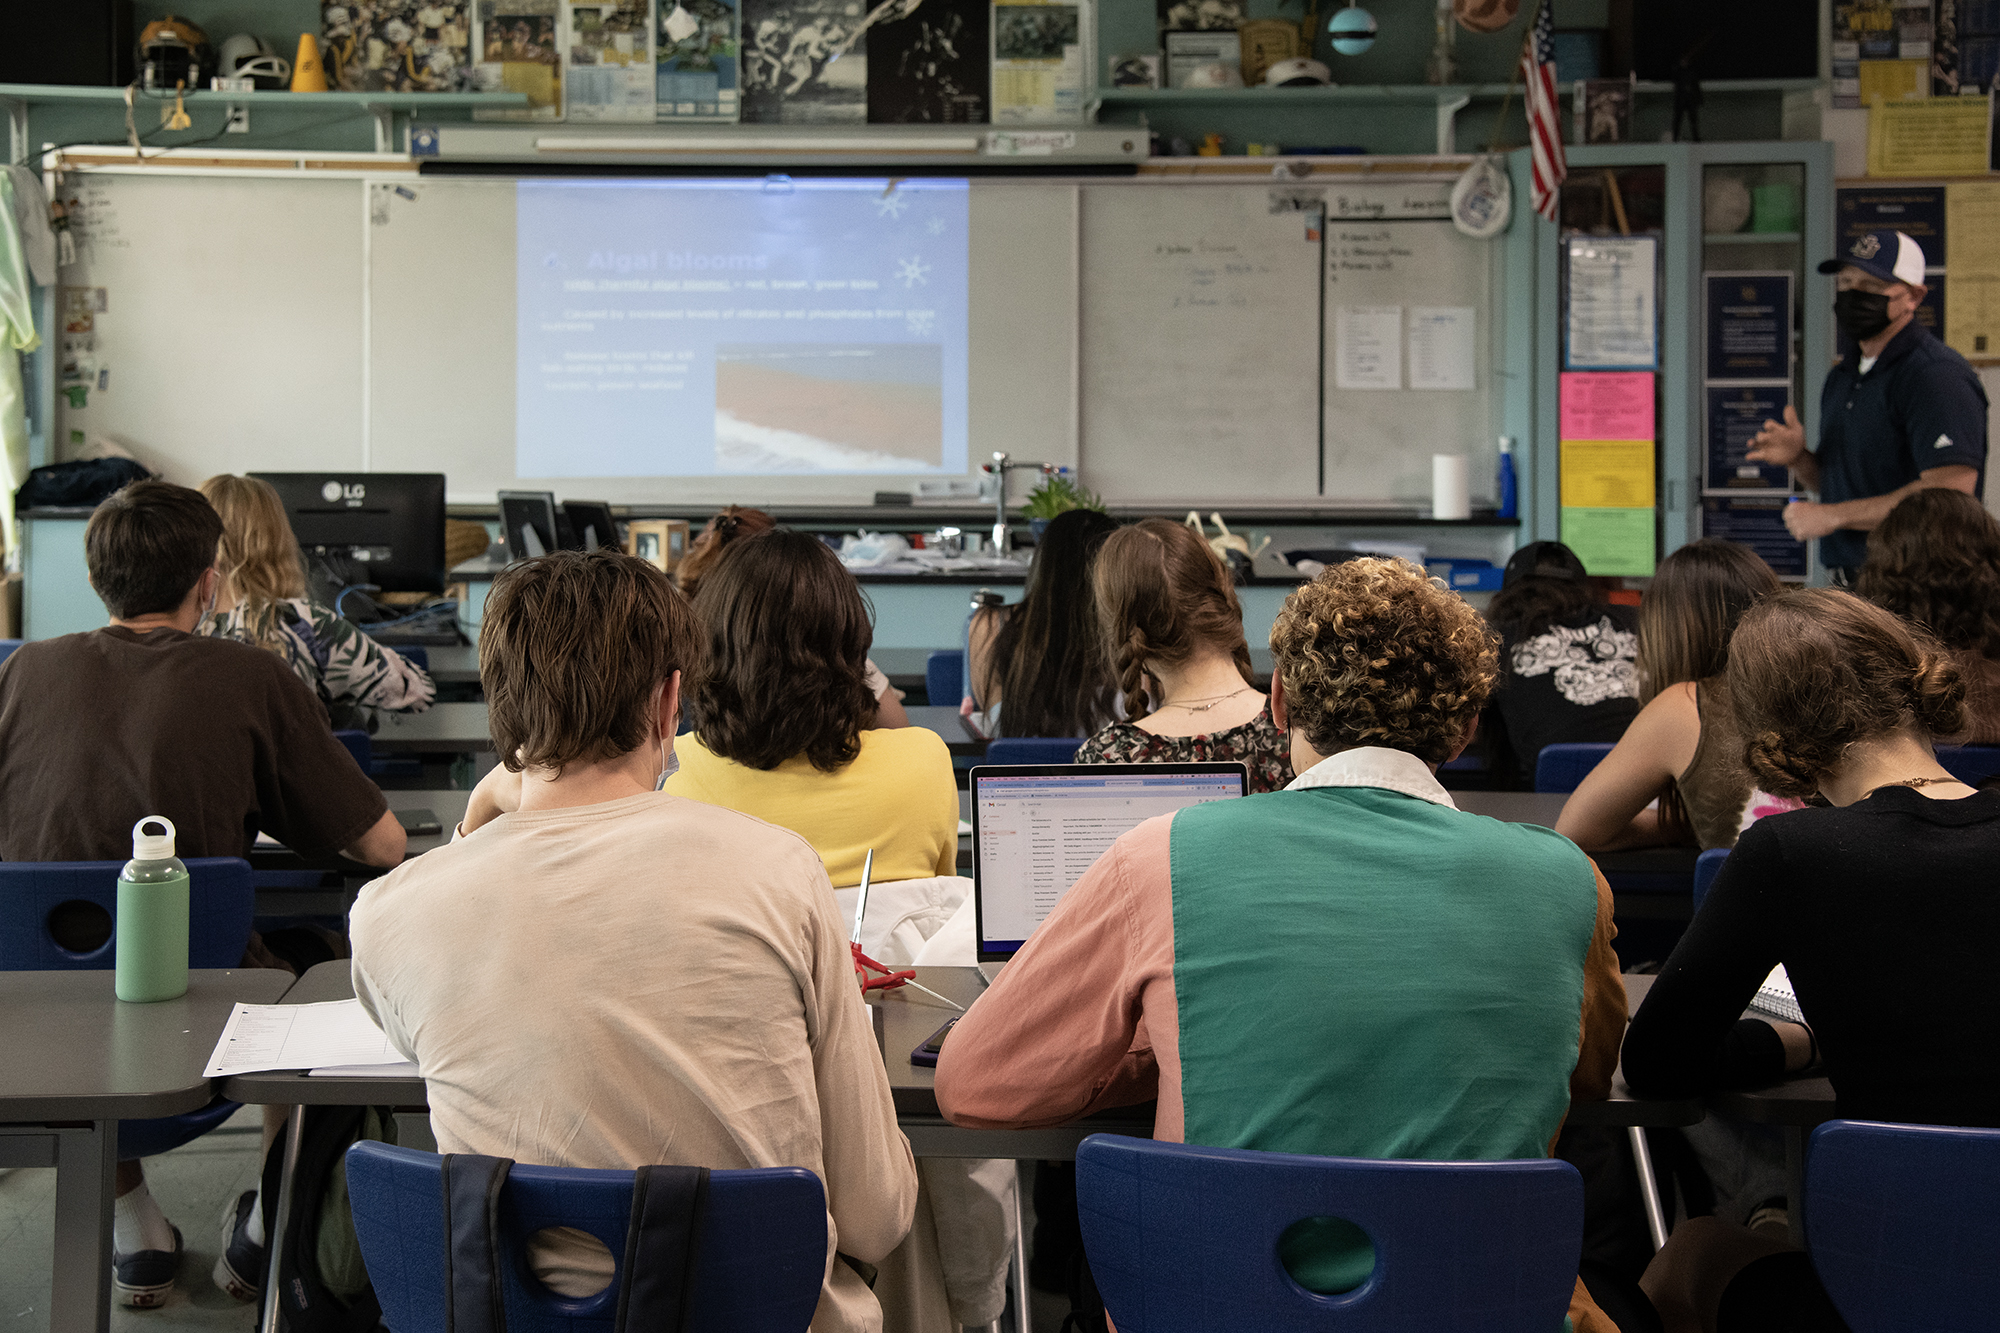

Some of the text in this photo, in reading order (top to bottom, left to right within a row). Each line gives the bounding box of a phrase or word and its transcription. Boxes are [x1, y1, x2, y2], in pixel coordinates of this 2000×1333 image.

[586, 250, 659, 273] Algal
[667, 250, 769, 270] blooms
[343, 483, 366, 499] LG
